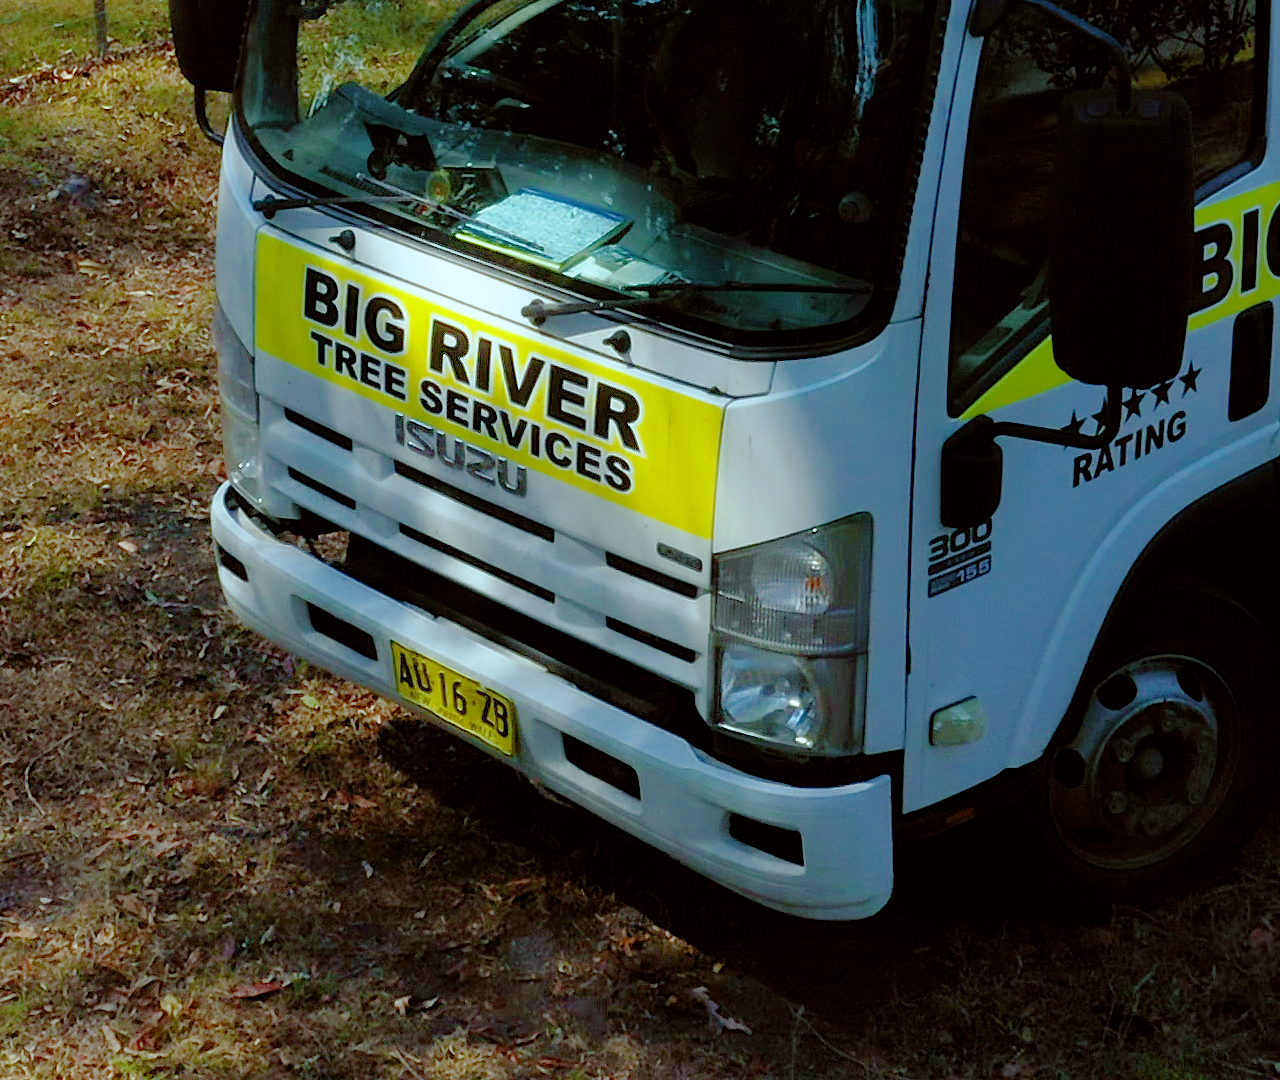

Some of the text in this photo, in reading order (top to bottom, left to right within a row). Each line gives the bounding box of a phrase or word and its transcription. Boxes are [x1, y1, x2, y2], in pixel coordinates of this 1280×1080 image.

[303, 266, 642, 453] BIG RIVER
[310, 331, 634, 494] TREE SERVICES
[1071, 409, 1188, 488] RATING
[394, 413, 528, 498] ISUZU
[928, 517, 993, 562] 300
[399, 652, 433, 694] AU
[438, 671, 468, 716] 16
[475, 687, 509, 738] ZB
